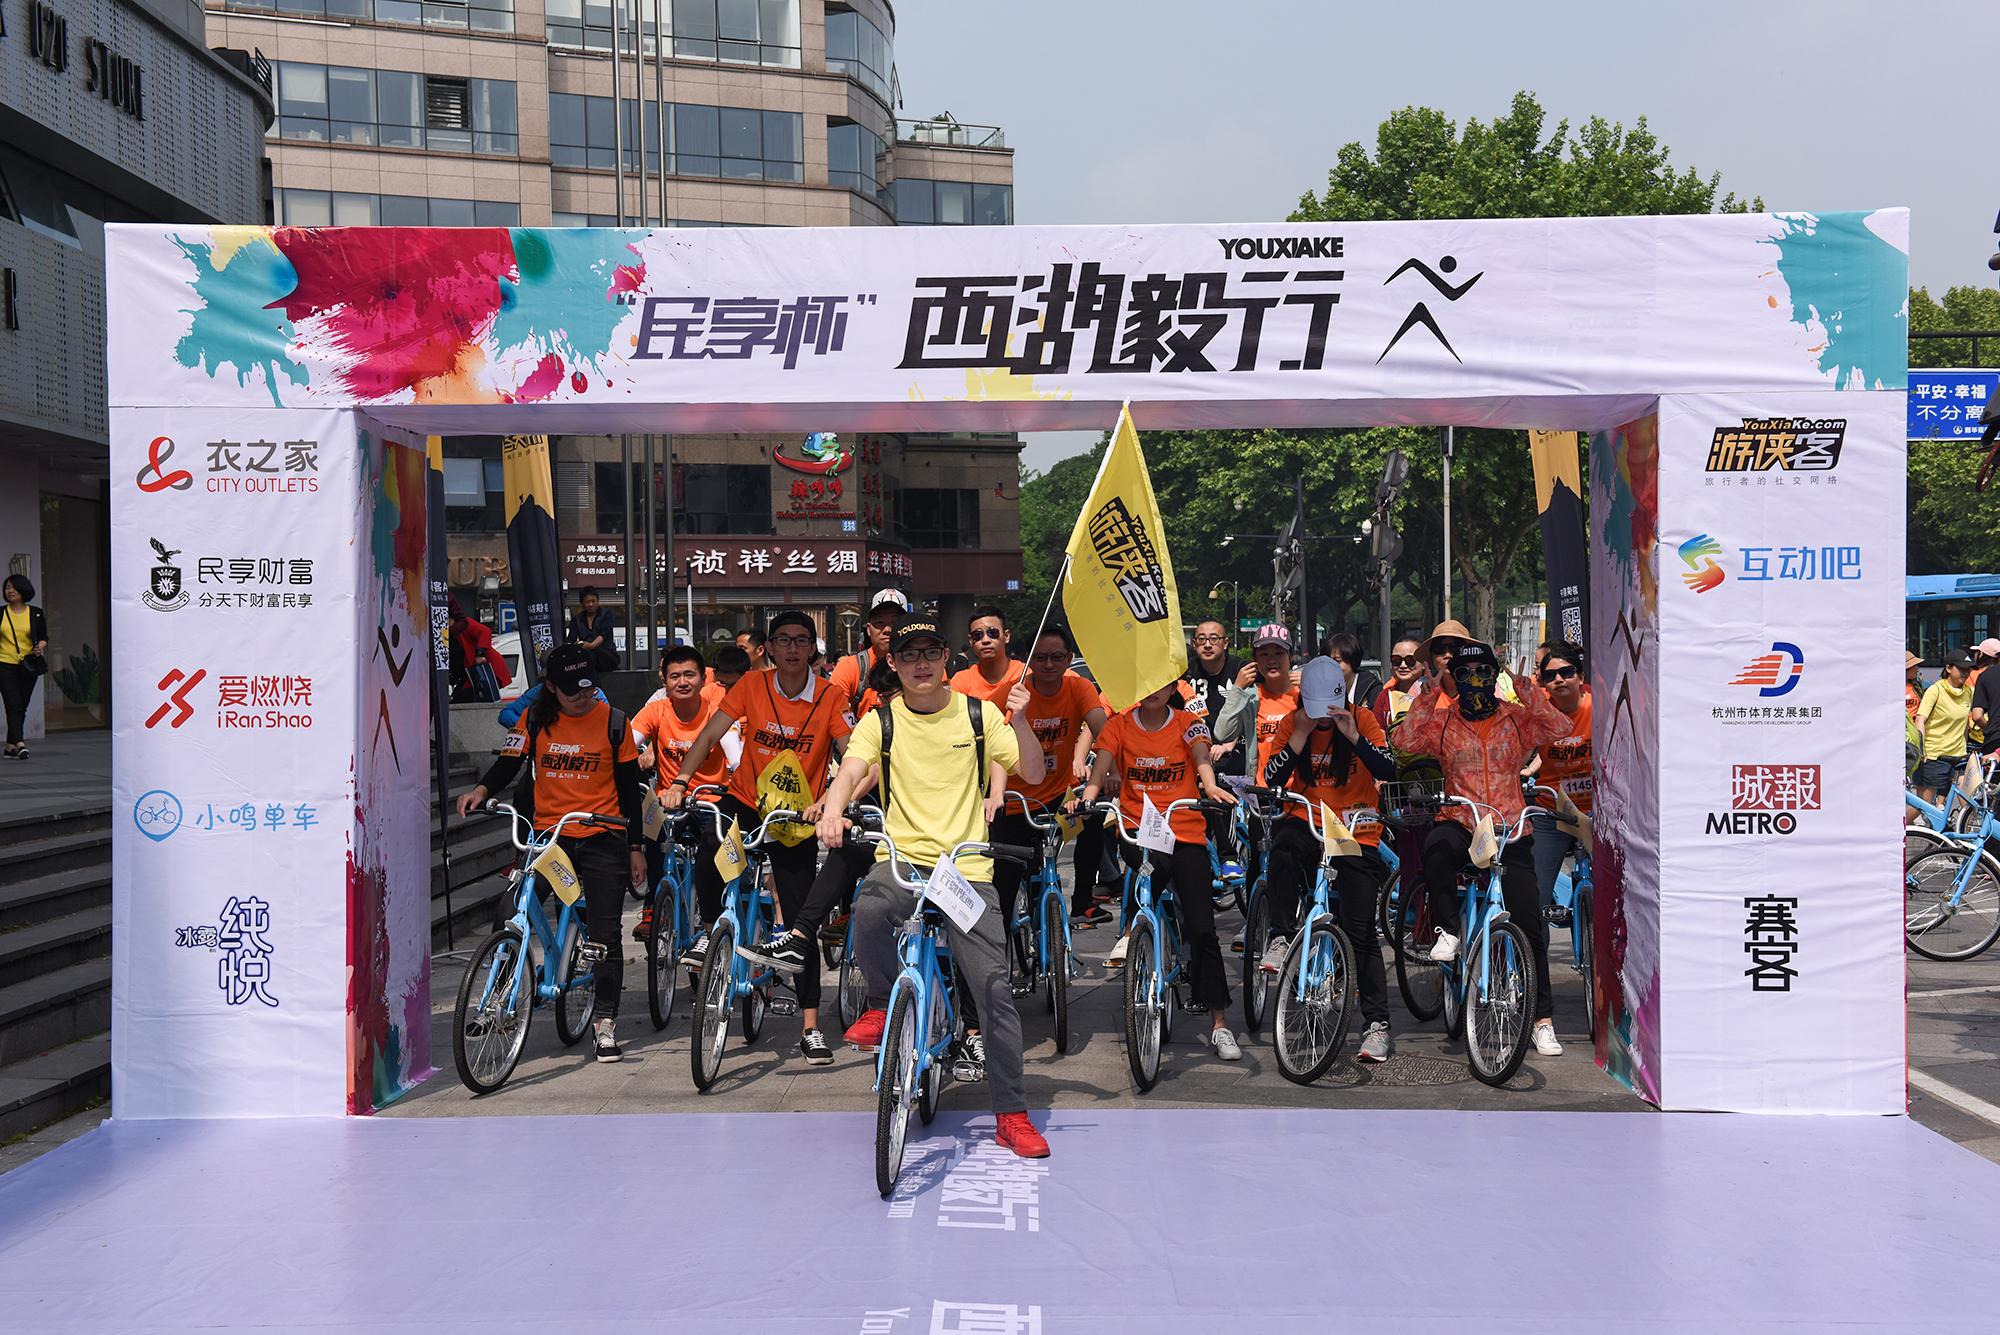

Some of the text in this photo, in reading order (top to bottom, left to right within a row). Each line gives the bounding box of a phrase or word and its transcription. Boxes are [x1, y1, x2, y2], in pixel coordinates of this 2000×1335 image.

[1219, 236, 1344, 260] YOUXIAKE
[894, 262, 1345, 374] 西湖毅行
[1743, 419, 1845, 430] YouXiaKe.com
[1916, 405, 1985, 421] 不分离
[206, 439, 319, 472] 衣之家
[1708, 432, 1840, 471] 游侠客
[206, 477, 319, 493] CITY OUTLETS
[1705, 475, 1837, 486] 旅行者的社交网络
[198, 557, 313, 584] 民享财富
[1737, 546, 1861, 581] 互动吧
[199, 592, 313, 608] 分天下财富民享
[501, 608, 517, 633] P
[898, 623, 936, 637] YOUXIAKE
[1259, 624, 1288, 640] NYC
[217, 675, 313, 707] 爱燃烧
[1712, 706, 1822, 719] 杭州市体育发展集团
[1566, 780, 1592, 792] 1145
[1732, 766, 1821, 810] 城報
[196, 803, 319, 831] 小鸣单车
[1705, 812, 1797, 835] METRO
[175, 926, 218, 948] 冰露
[219, 896, 279, 1007] 纯悦
